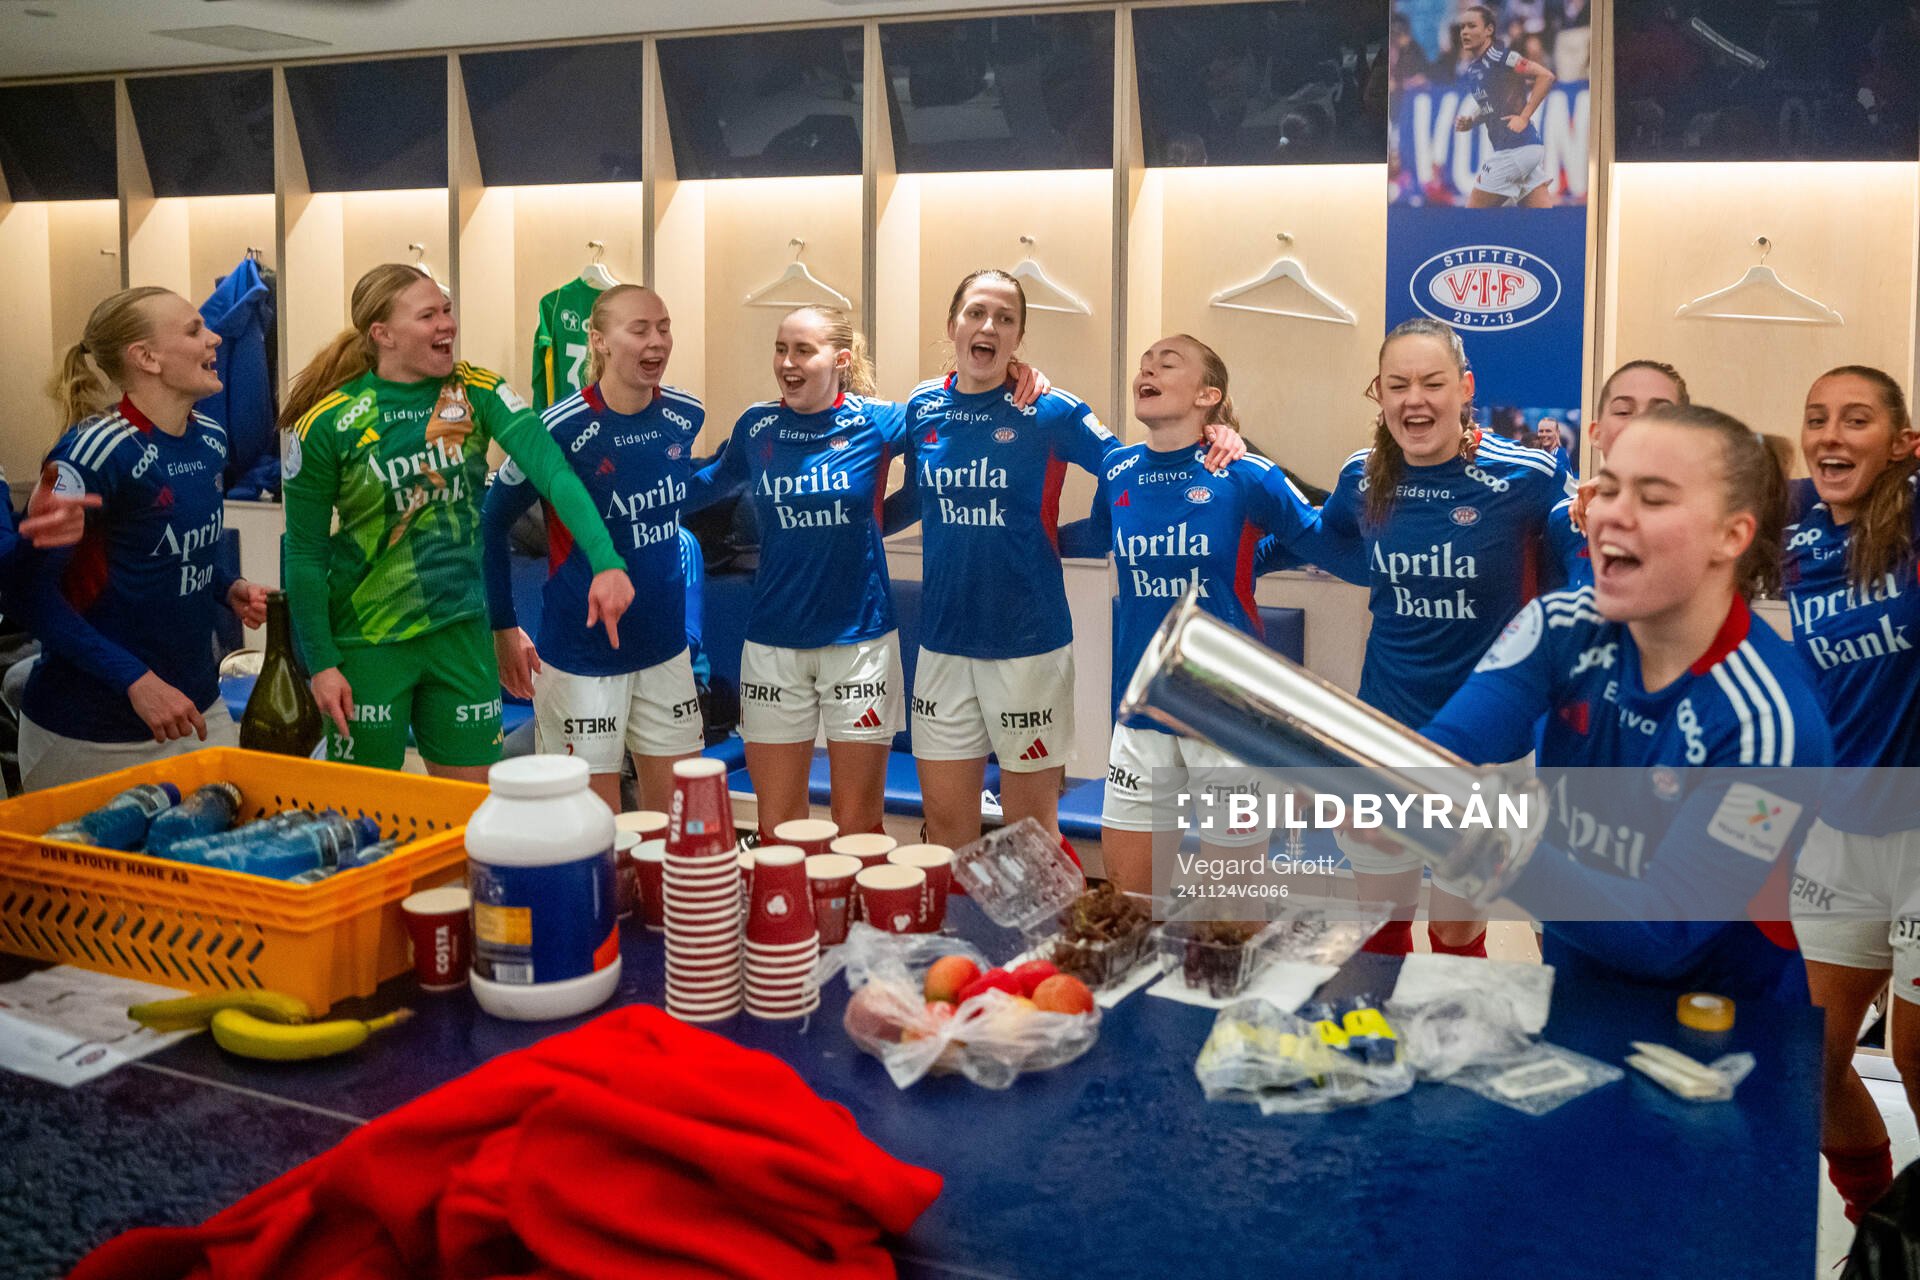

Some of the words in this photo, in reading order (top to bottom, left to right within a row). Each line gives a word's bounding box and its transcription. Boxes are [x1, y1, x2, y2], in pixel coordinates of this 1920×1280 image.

[1444, 250, 1527, 267] STIFTET
[1453, 312, 1514, 325] 29-7-13
[337, 397, 372, 432] coop
[662, 407, 692, 431] coop
[916, 397, 944, 419] coop
[571, 421, 601, 453] coop
[749, 414, 778, 437] coop
[131, 443, 159, 479] coop
[202, 434, 227, 459] coop
[363, 436, 466, 489] Aprila
[756, 463, 851, 503] Aprila
[919, 456, 1009, 495] Aprila
[1106, 453, 1140, 481] coop
[1464, 464, 1510, 493] coop
[604, 474, 687, 521] Aprila
[938, 496, 1007, 527] Bank
[776, 500, 850, 529] Bank
[1114, 521, 1211, 566] Aprila
[1370, 541, 1479, 583] Aprila
[1130, 566, 1210, 598] Bank
[1392, 587, 1478, 619] Bank
[1807, 613, 1913, 670] Bank
[333, 731, 355, 760] 32
[41, 847, 68, 862] DEN
[74, 853, 121, 873] STOLTE
[127, 862, 165, 880] HANE
[171, 870, 189, 884] AS
[436, 925, 450, 974] COSTA
